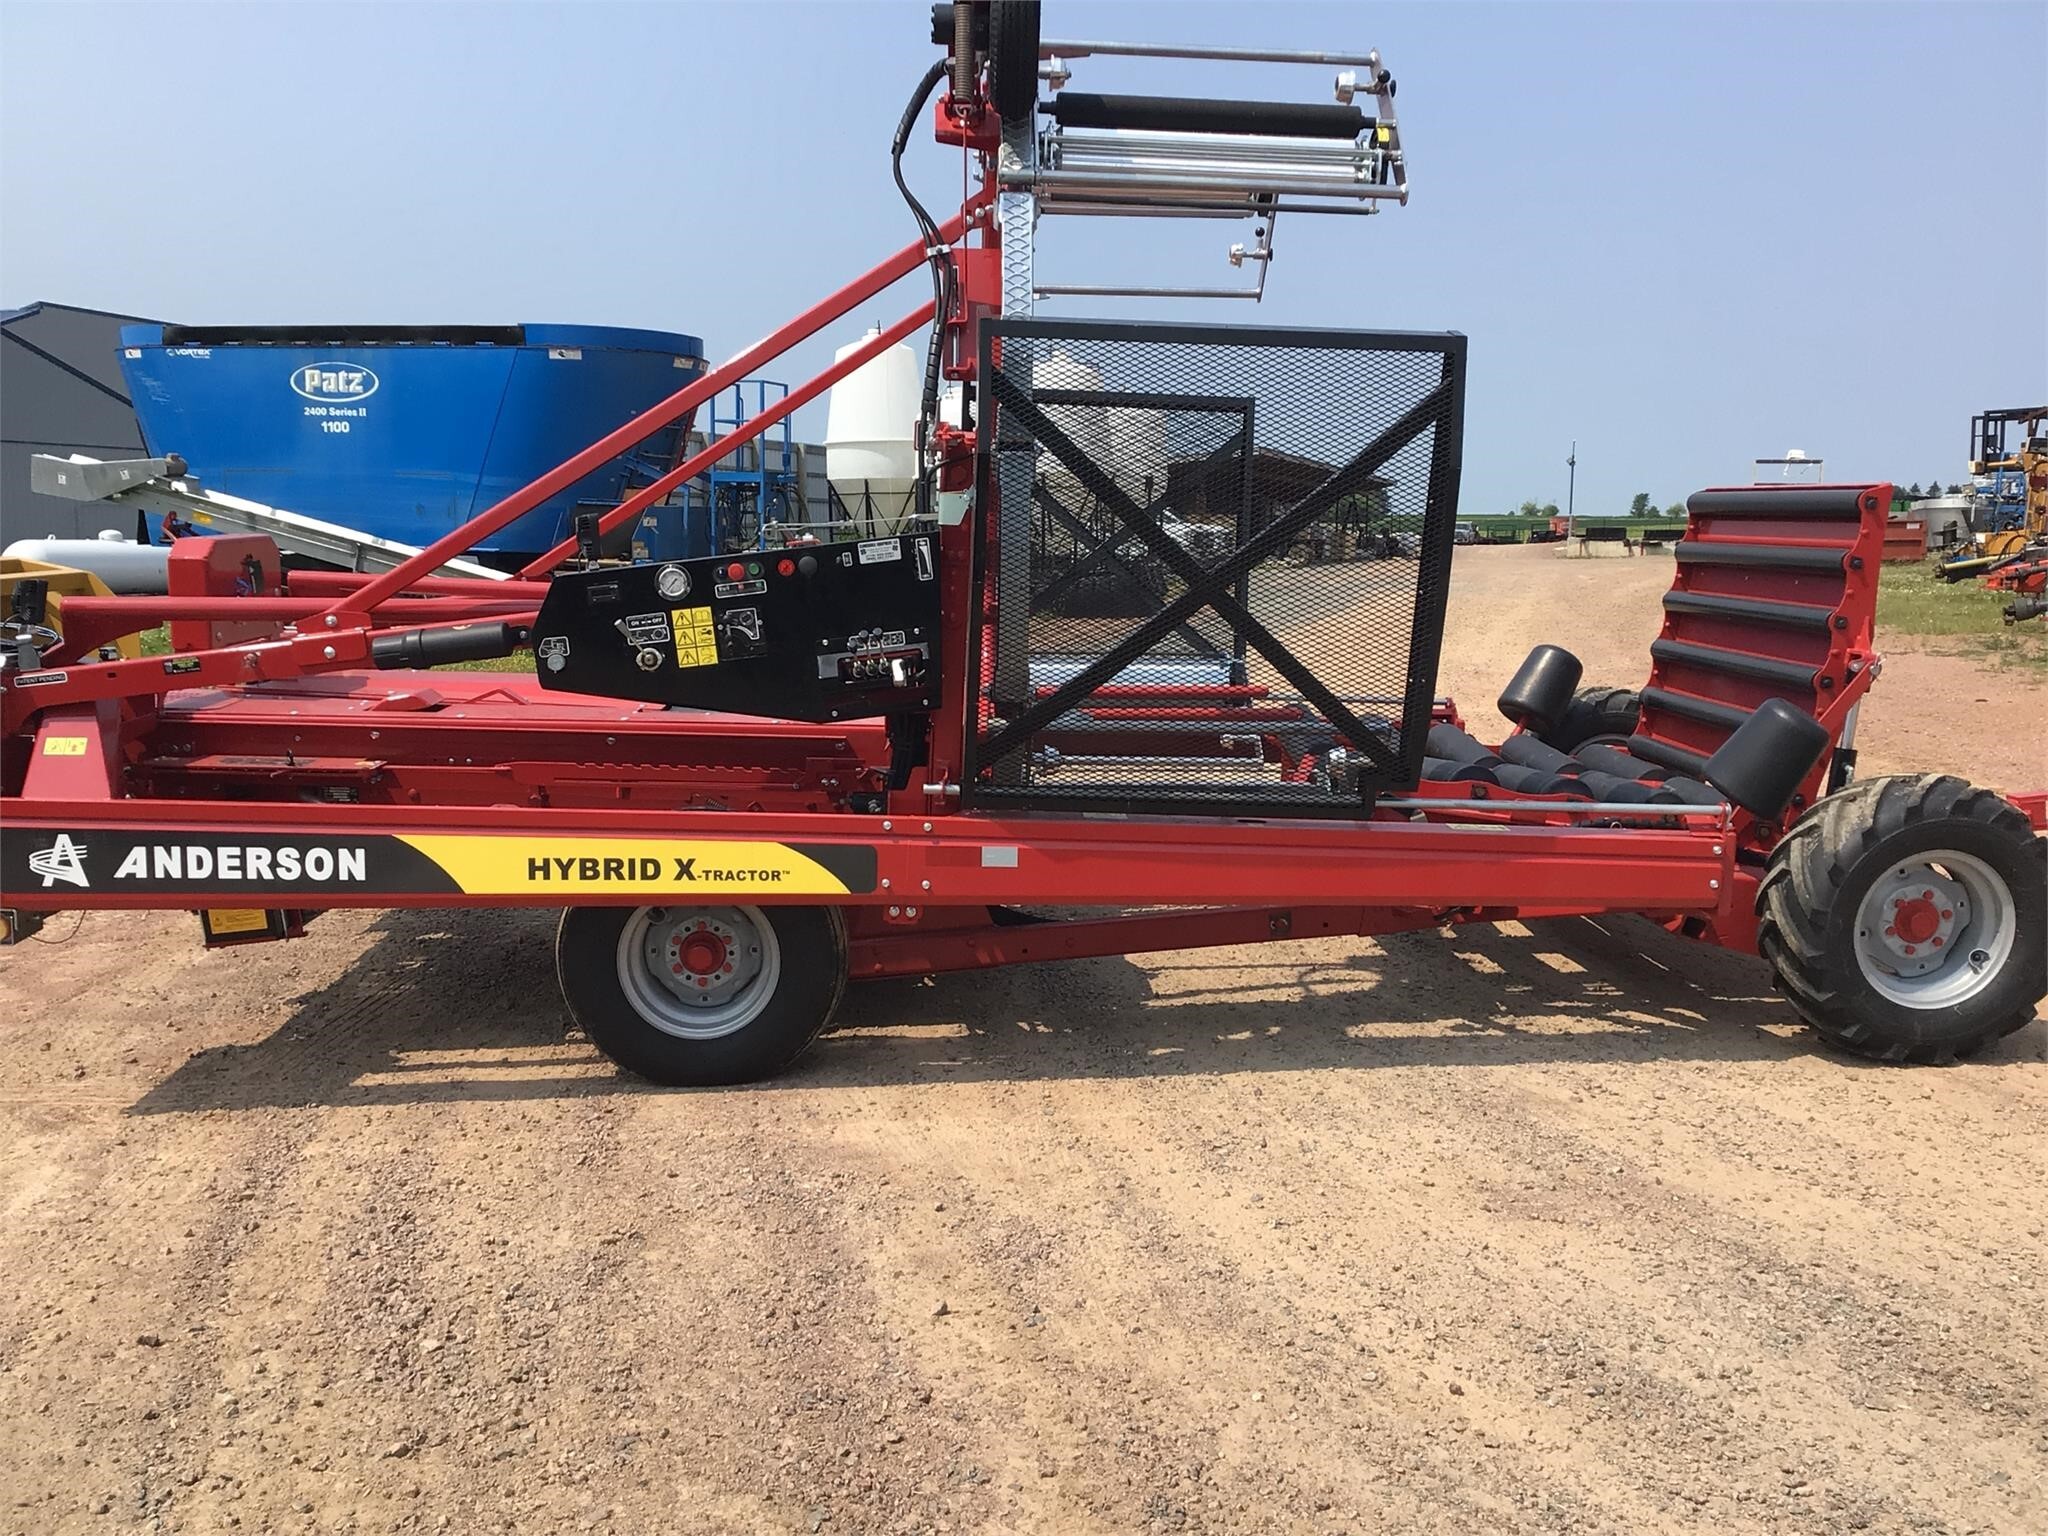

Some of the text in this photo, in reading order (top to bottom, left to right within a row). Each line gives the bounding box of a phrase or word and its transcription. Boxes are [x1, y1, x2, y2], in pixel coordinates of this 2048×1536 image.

[304, 369, 364, 393] Patz
[304, 407, 327, 416] 2400
[329, 407, 357, 417] Series
[321, 421, 350, 433] 1100
[113, 846, 366, 881] ANDERSON
[527, 857, 662, 881] HYBRID
